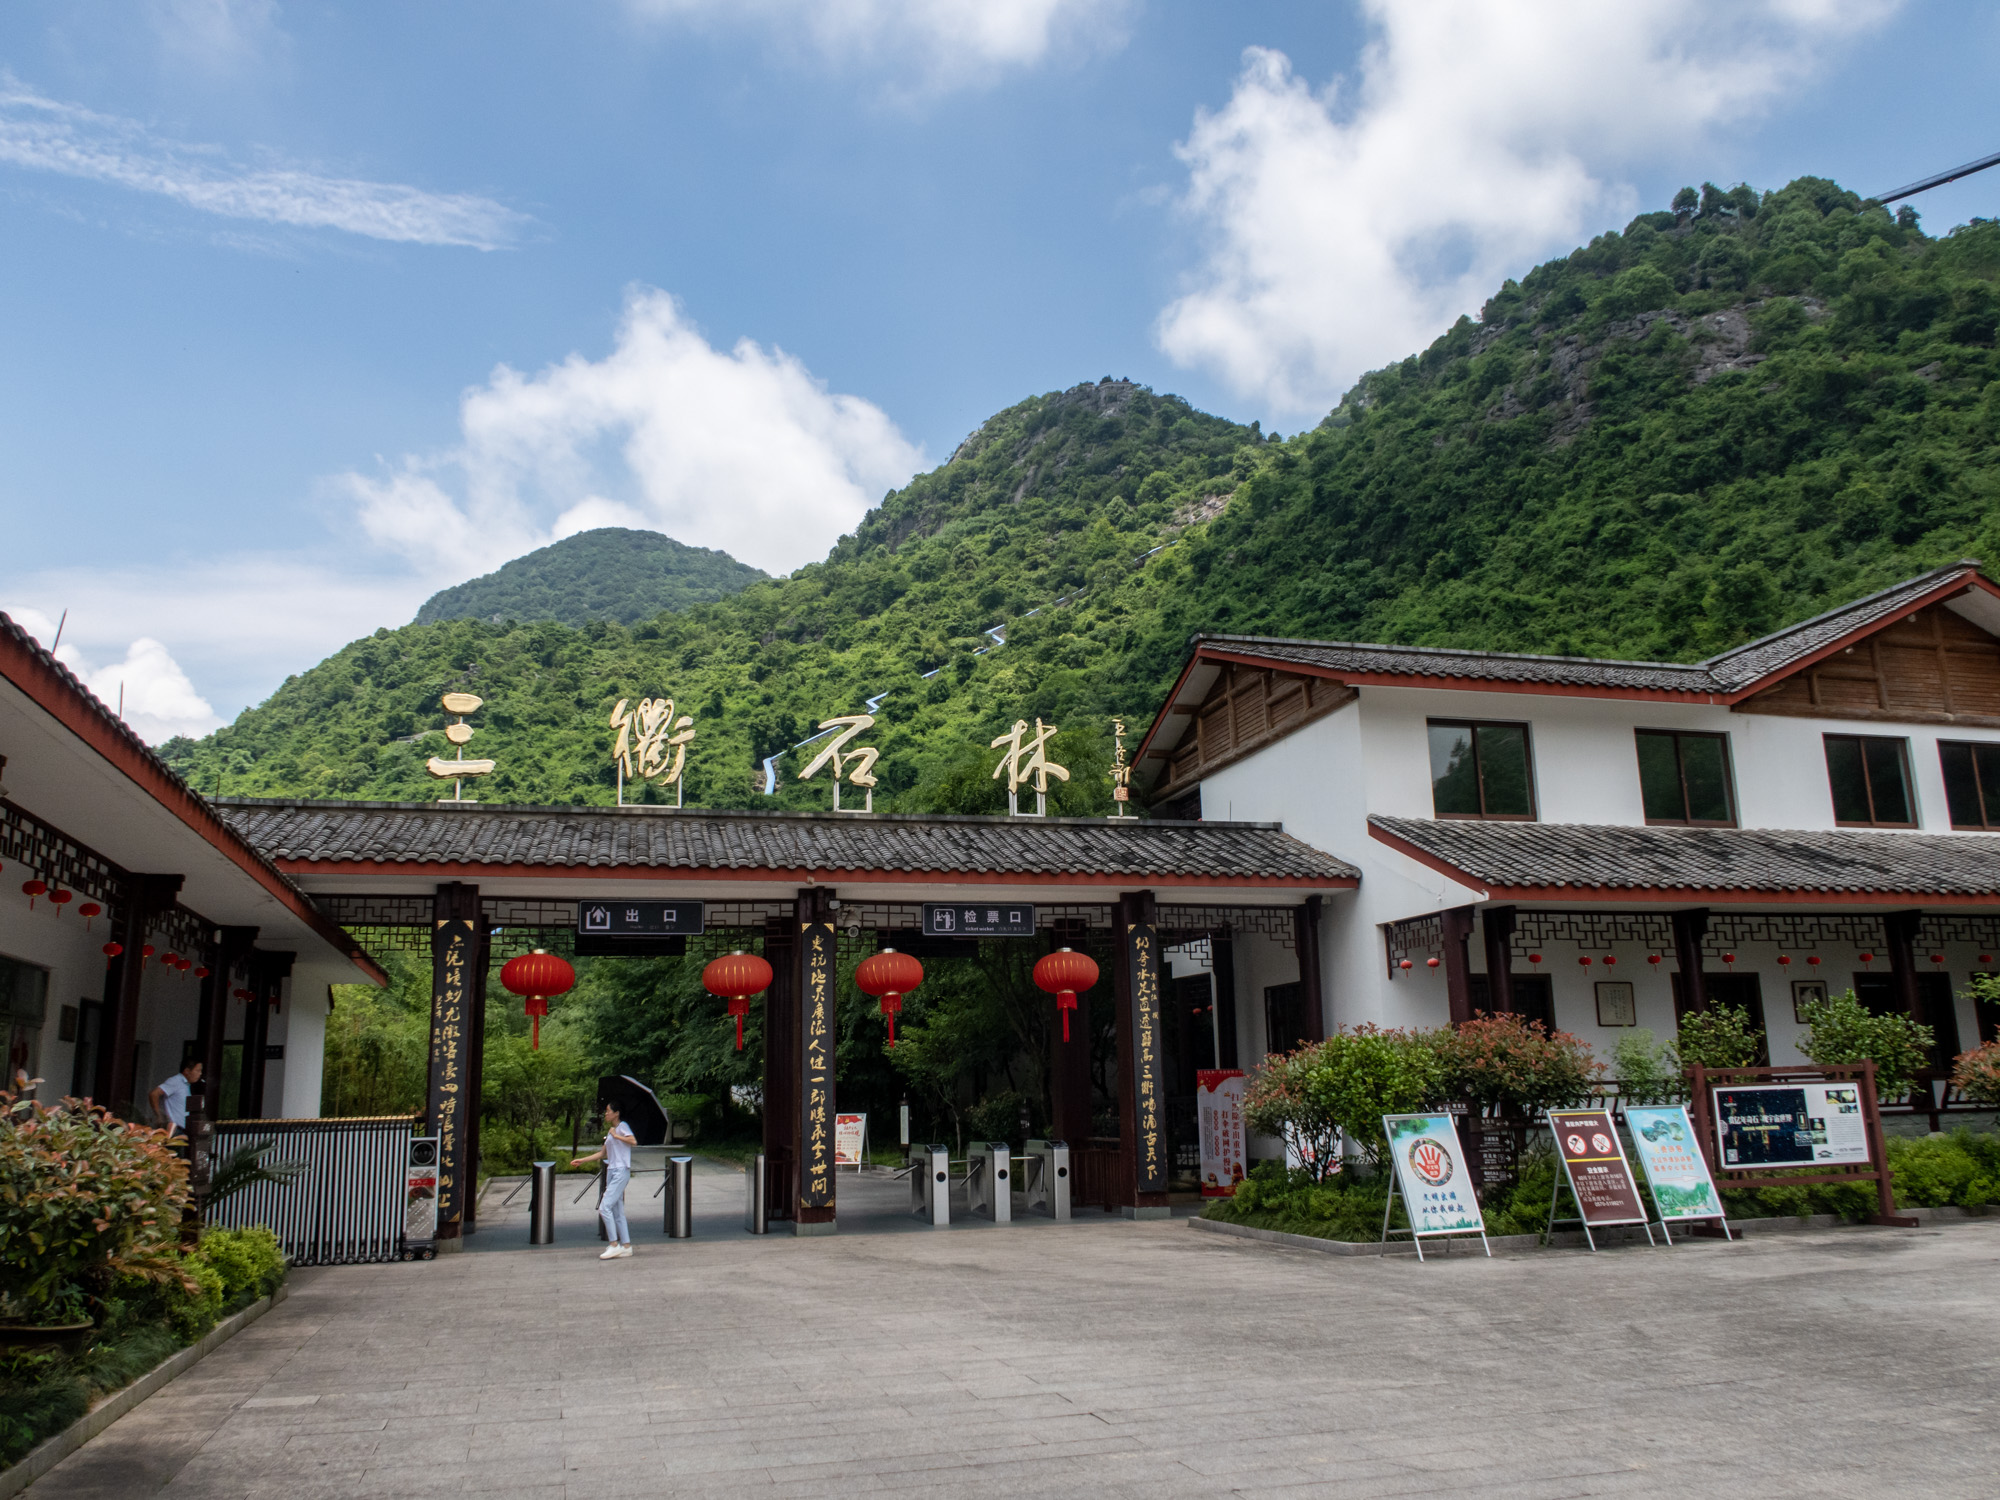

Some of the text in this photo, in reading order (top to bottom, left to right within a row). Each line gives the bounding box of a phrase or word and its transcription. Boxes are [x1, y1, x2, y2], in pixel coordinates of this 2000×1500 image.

[625, 908, 677, 923] 出口
[964, 909, 1022, 923] 检票口
[1423, 1191, 1457, 1202] 文明出游
[1422, 1203, 1466, 1214] 从你我做起
